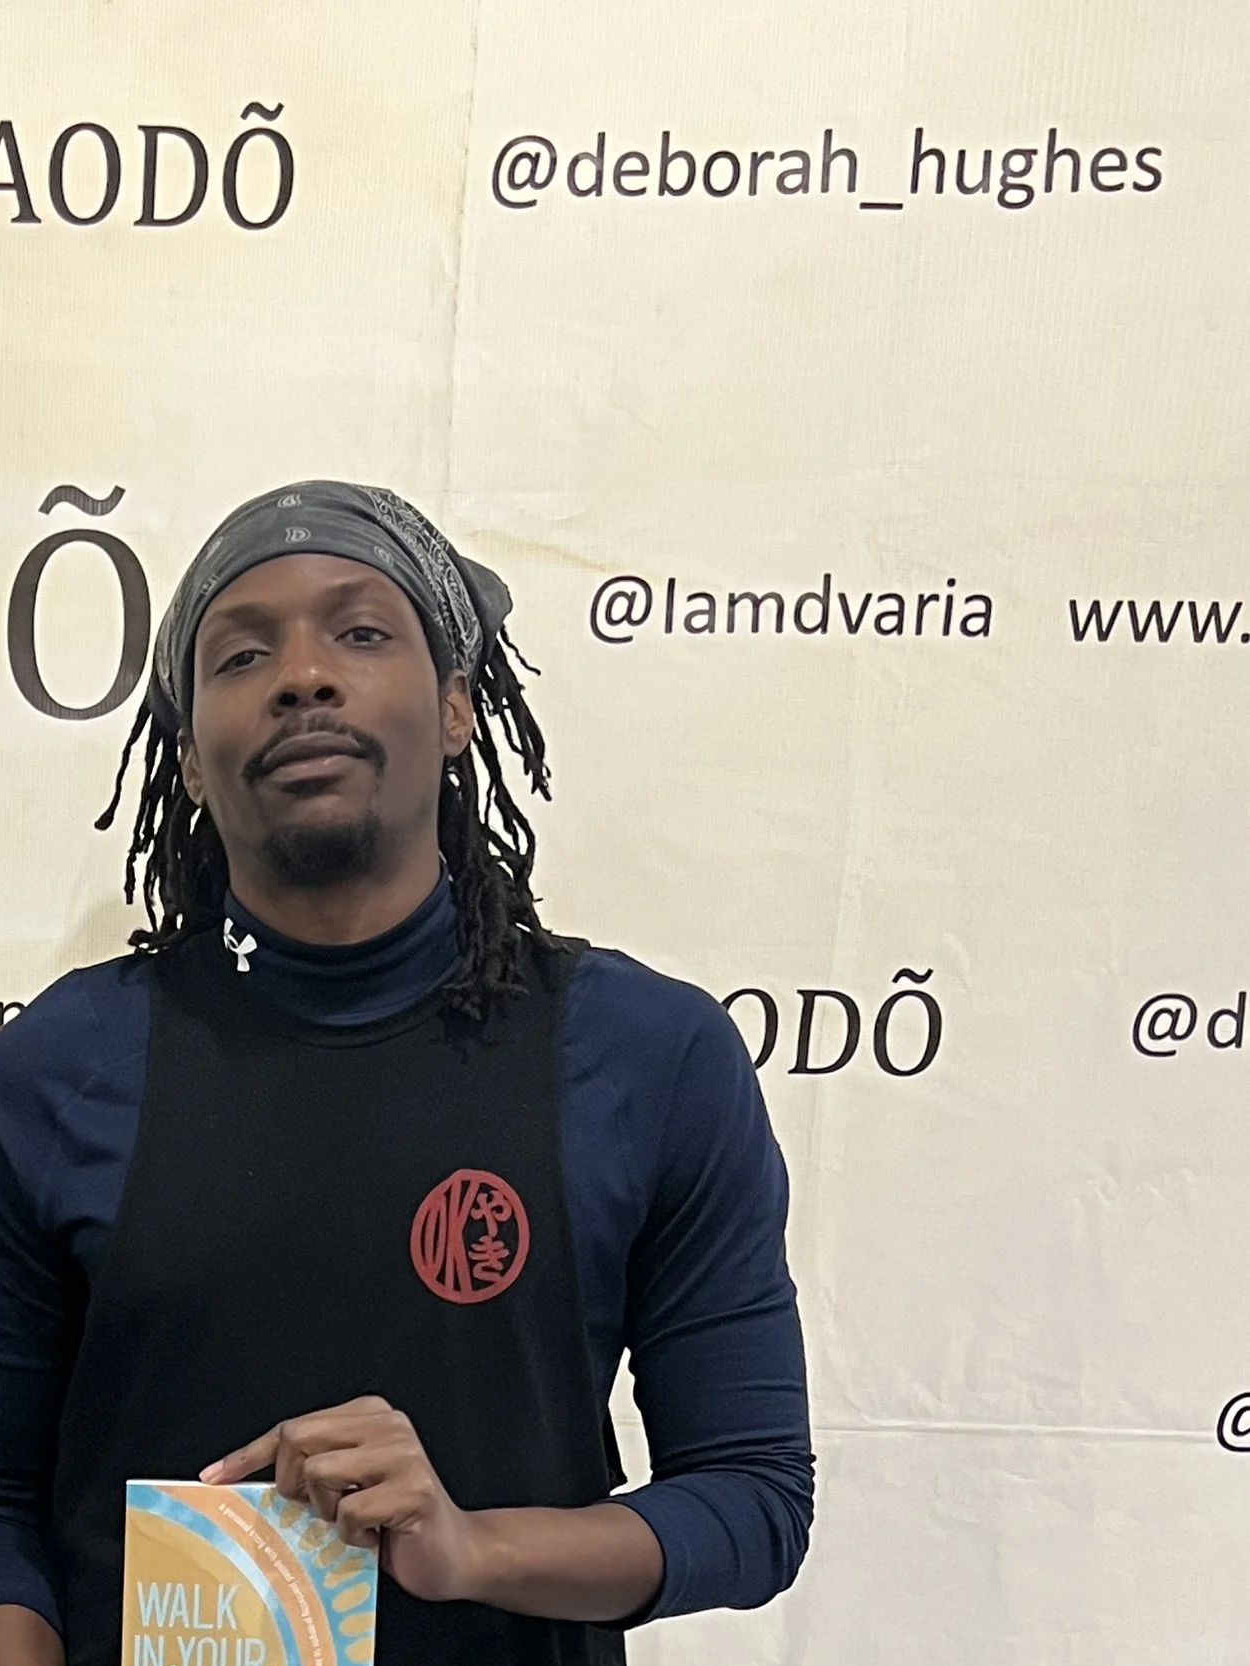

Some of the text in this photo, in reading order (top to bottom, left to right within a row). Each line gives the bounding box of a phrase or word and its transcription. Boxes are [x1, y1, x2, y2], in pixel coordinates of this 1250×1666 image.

[491, 127, 1163, 211] @deborah_hughes
[589, 573, 993, 645] @Iamdvaria
[135, 1581, 239, 1630] WALK
